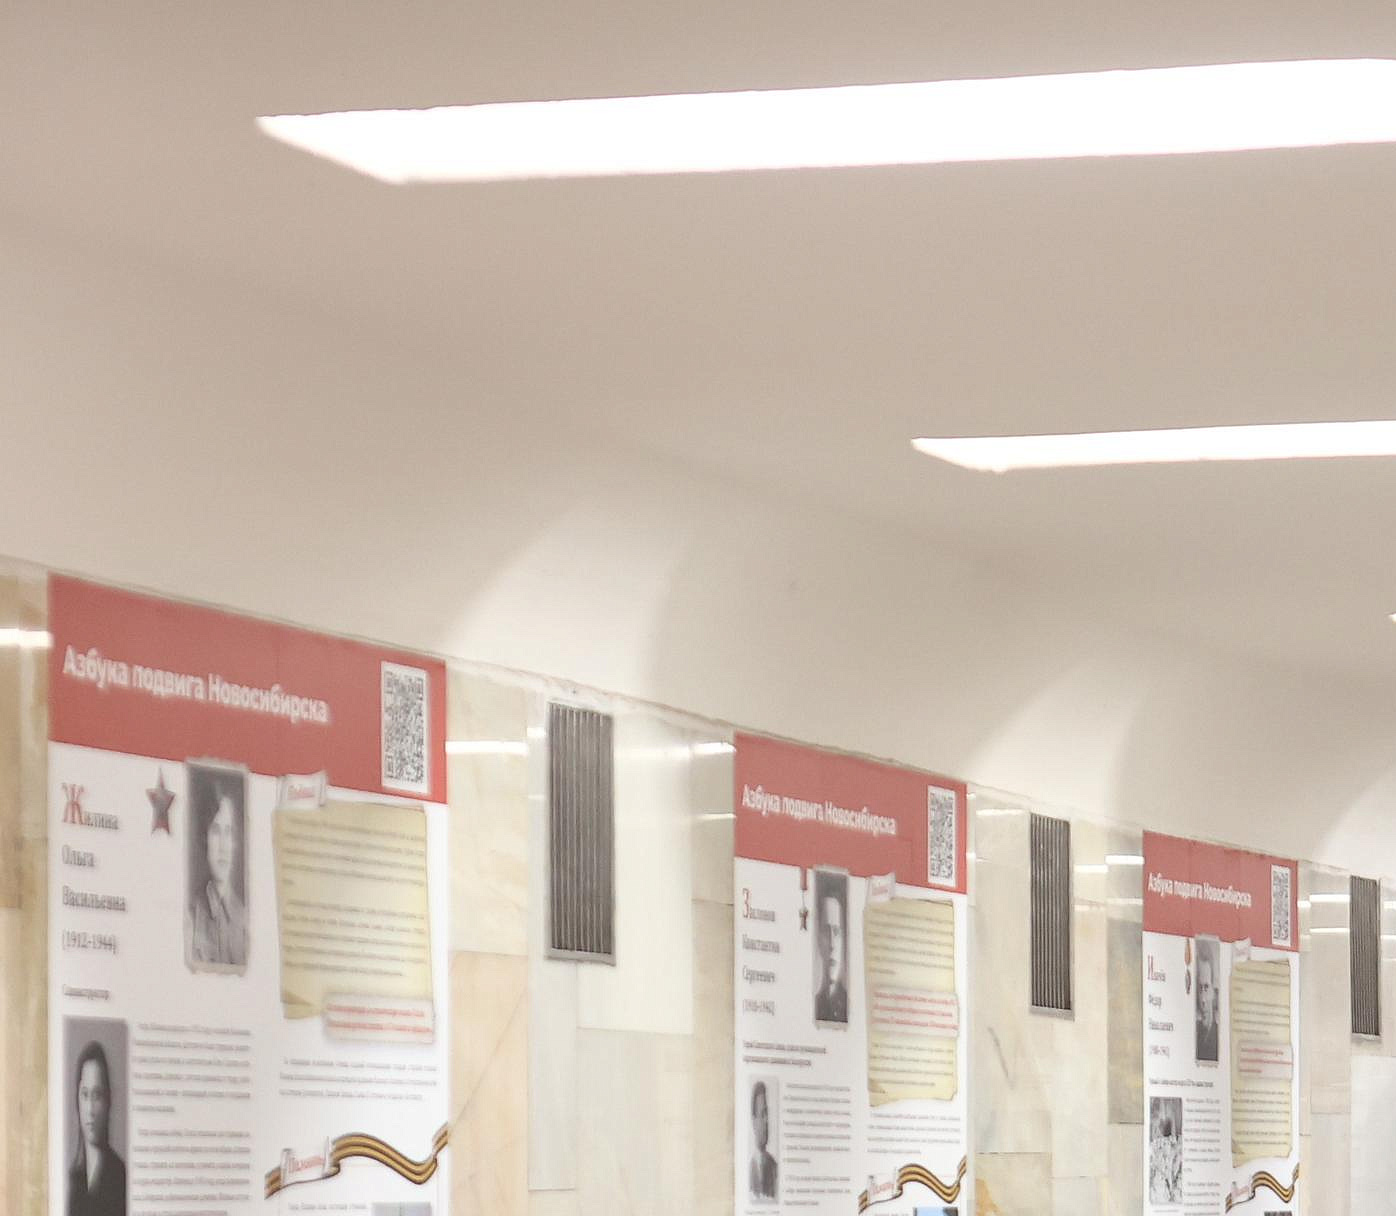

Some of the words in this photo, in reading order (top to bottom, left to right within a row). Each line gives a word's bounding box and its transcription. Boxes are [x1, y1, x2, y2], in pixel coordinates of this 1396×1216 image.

[62, 644, 129, 689] Азбука
[132, 663, 204, 699] подвига
[207, 672, 330, 723] Новосибирска
[742, 784, 780, 816] Азбука
